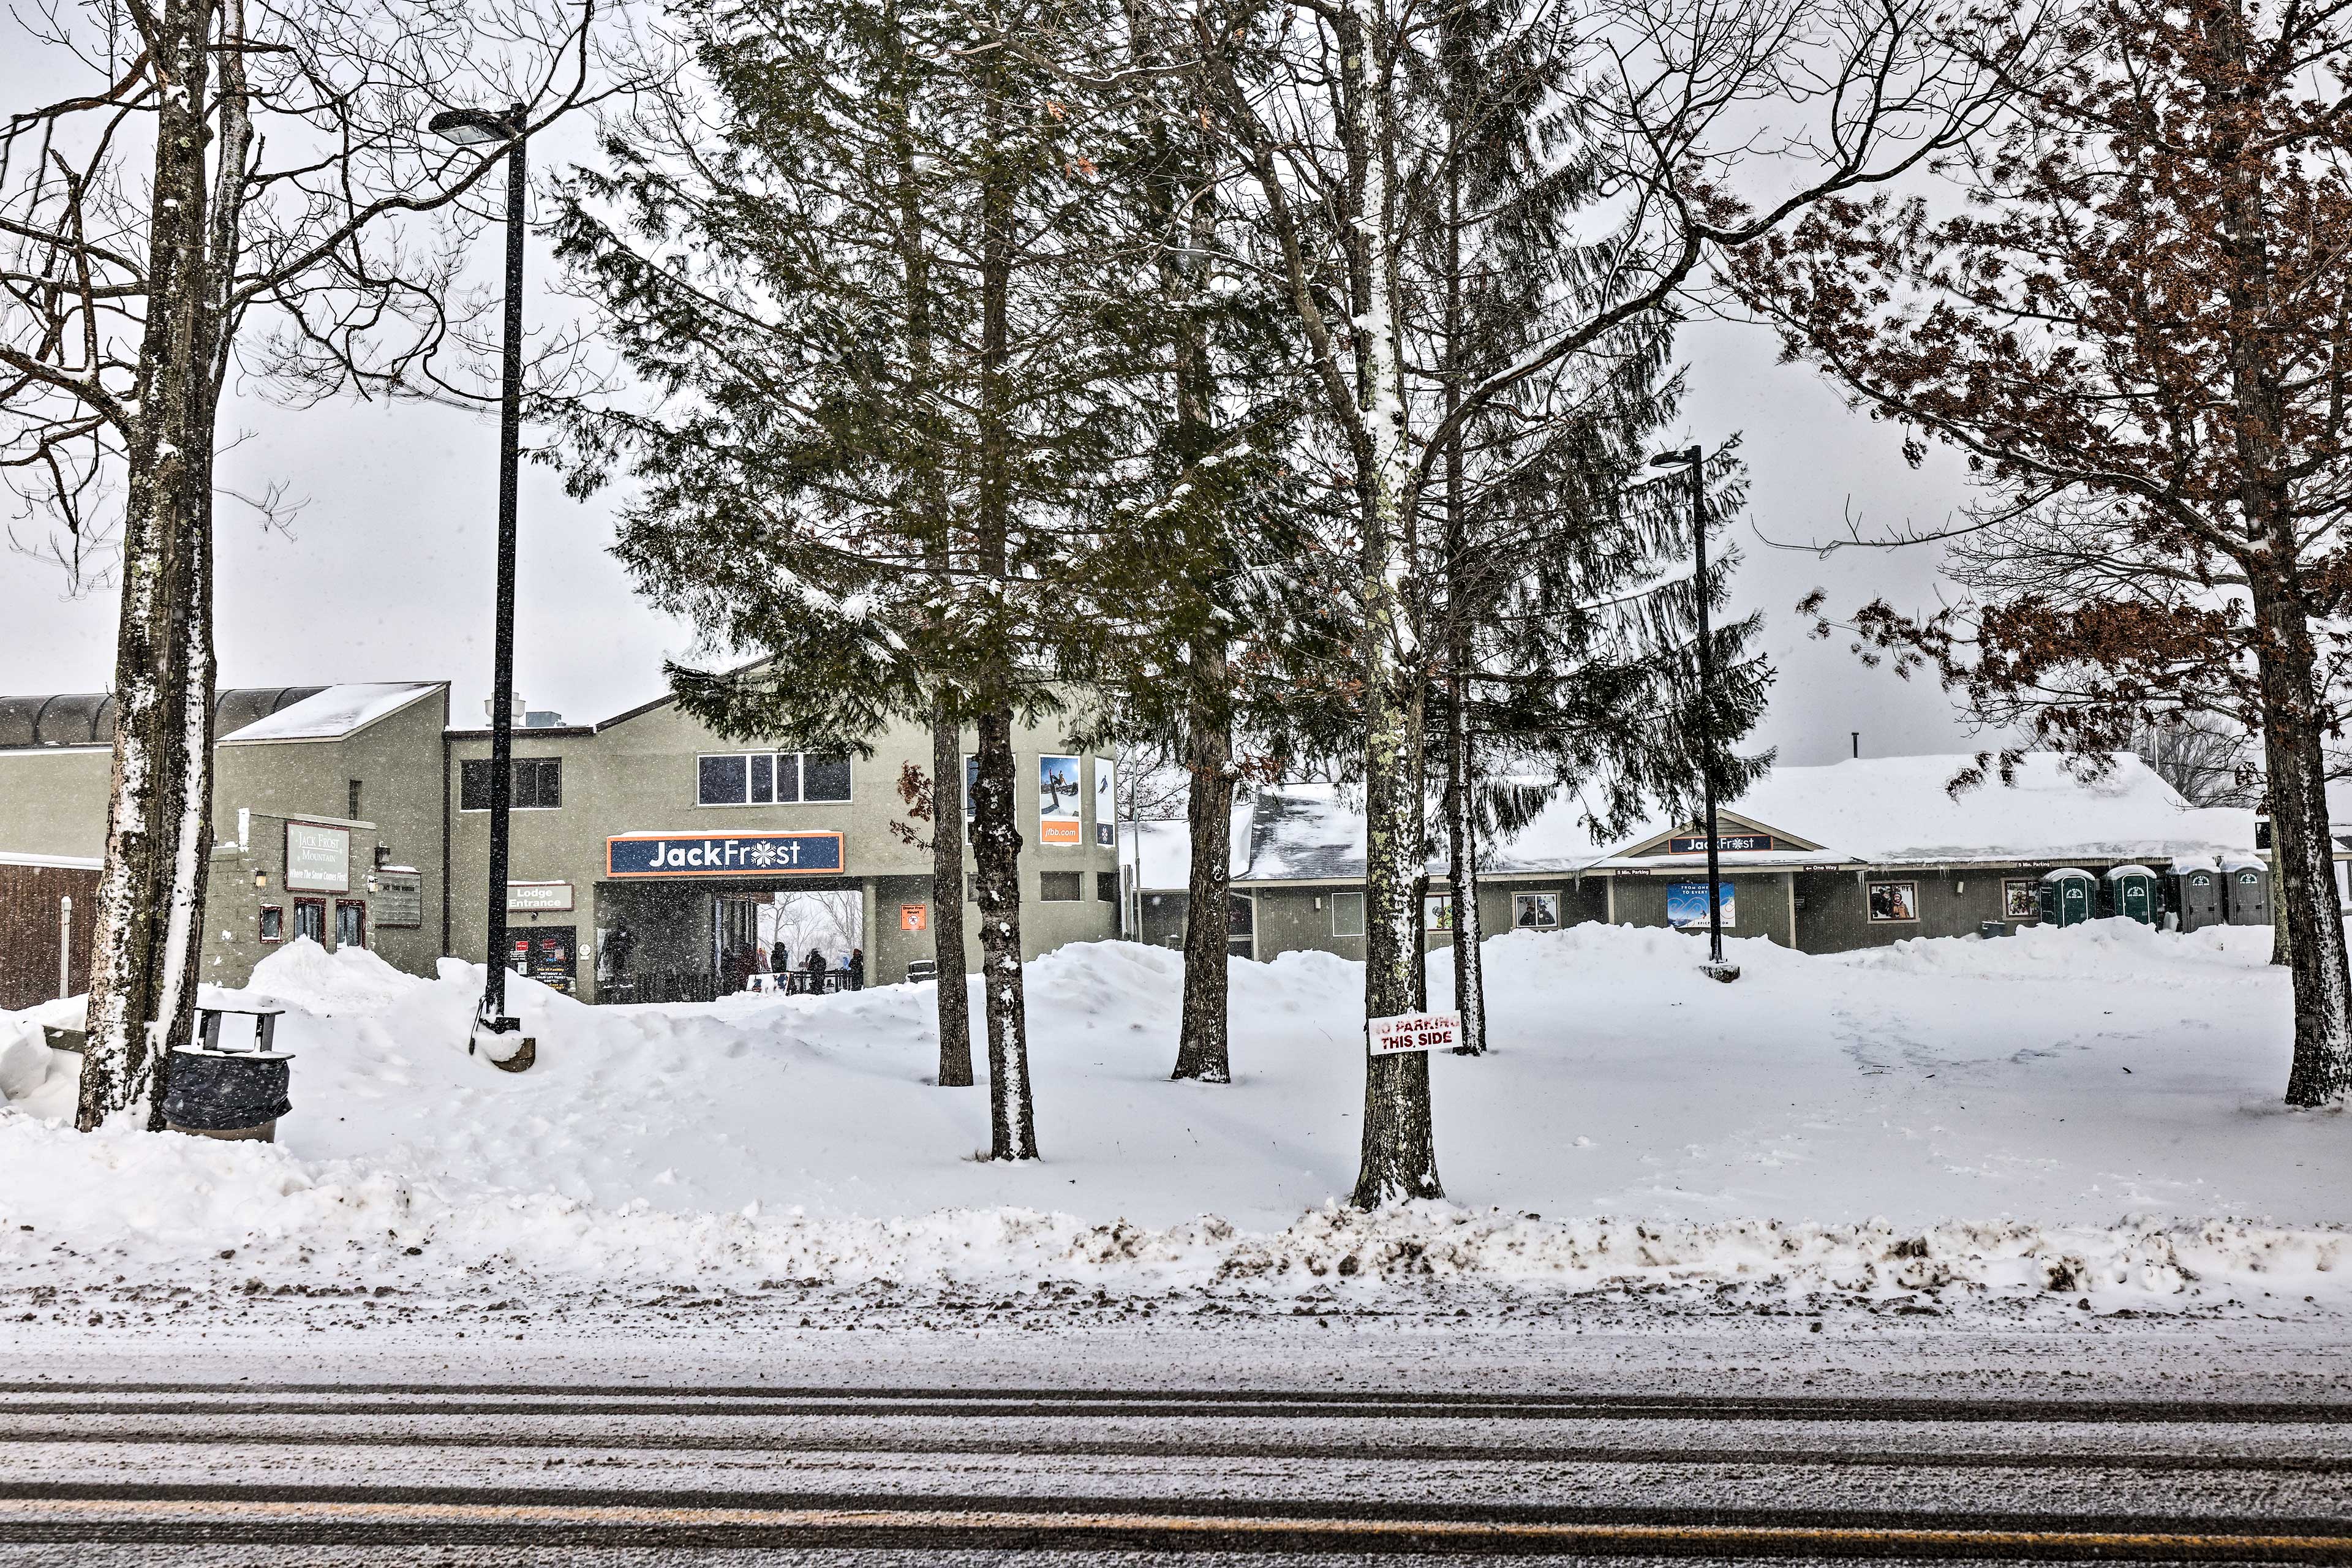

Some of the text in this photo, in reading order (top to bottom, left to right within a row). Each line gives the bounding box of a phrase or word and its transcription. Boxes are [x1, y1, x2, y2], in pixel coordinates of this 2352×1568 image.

[1045, 827, 1076, 837] jfbb.com
[298, 831, 340, 849] JACK FROST
[302, 849, 336, 862] MOUNTAIN
[289, 868, 303, 878] Where
[517, 888, 553, 898] Lodge
[508, 899, 561, 908] Entrance
[1381, 1031, 1452, 1050] THIS SIDE
